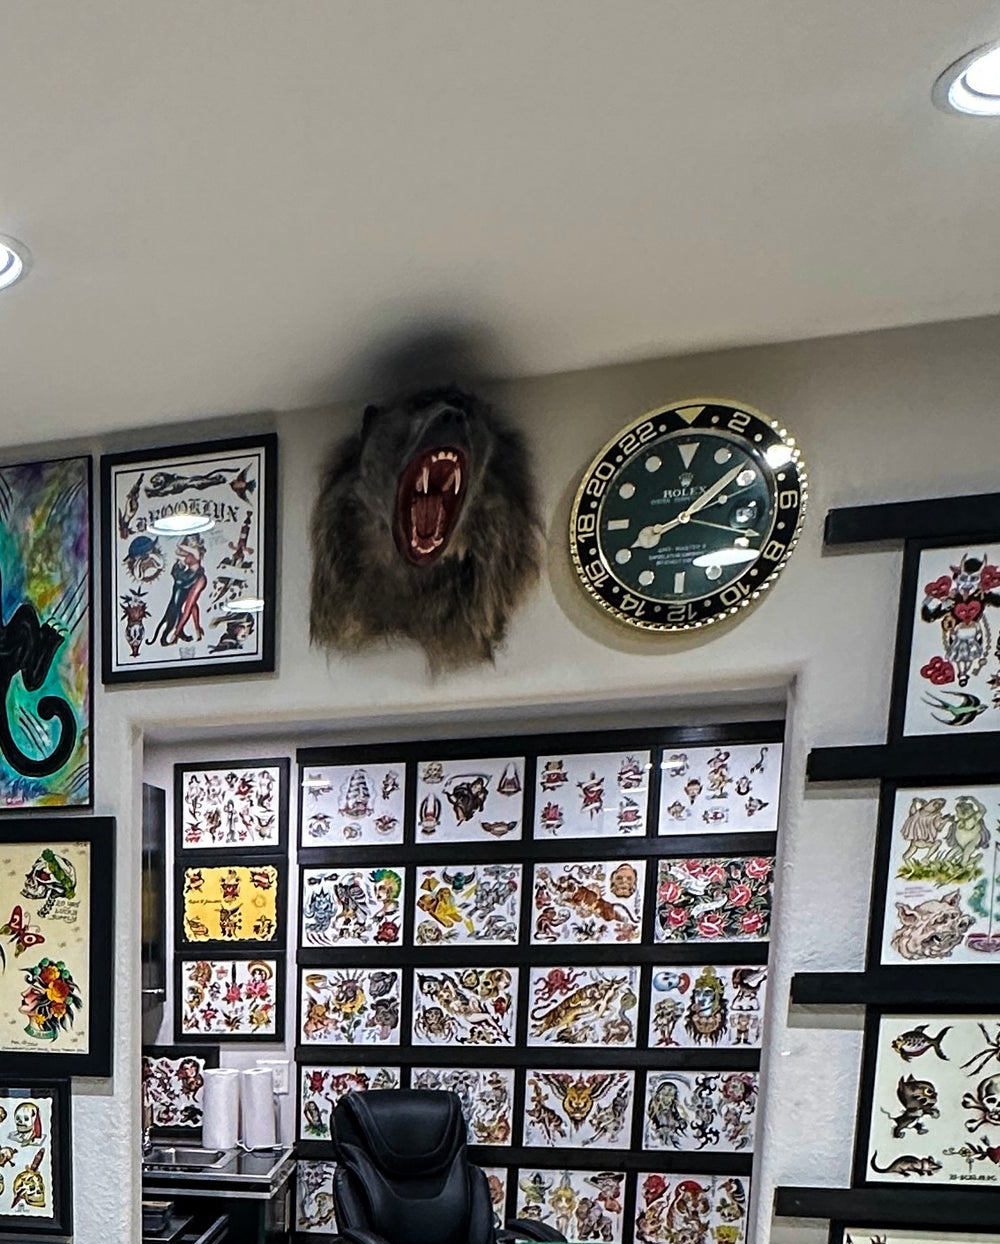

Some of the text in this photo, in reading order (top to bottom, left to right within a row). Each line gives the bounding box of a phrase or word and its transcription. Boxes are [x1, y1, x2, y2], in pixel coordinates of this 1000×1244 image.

[727, 411, 752, 433] 2
[617, 420, 658, 455] 22
[586, 464, 616, 497] 20
[663, 485, 707, 498] ROLEX
[779, 489, 798, 510] 6
[136, 498, 240, 532] BROOKLYN
[577, 513, 596, 544] 18
[762, 540, 784, 561] 8
[584, 561, 608, 589] 16
[620, 592, 646, 617] 14
[719, 582, 751, 607] 10
[666, 603, 698, 622] 12
